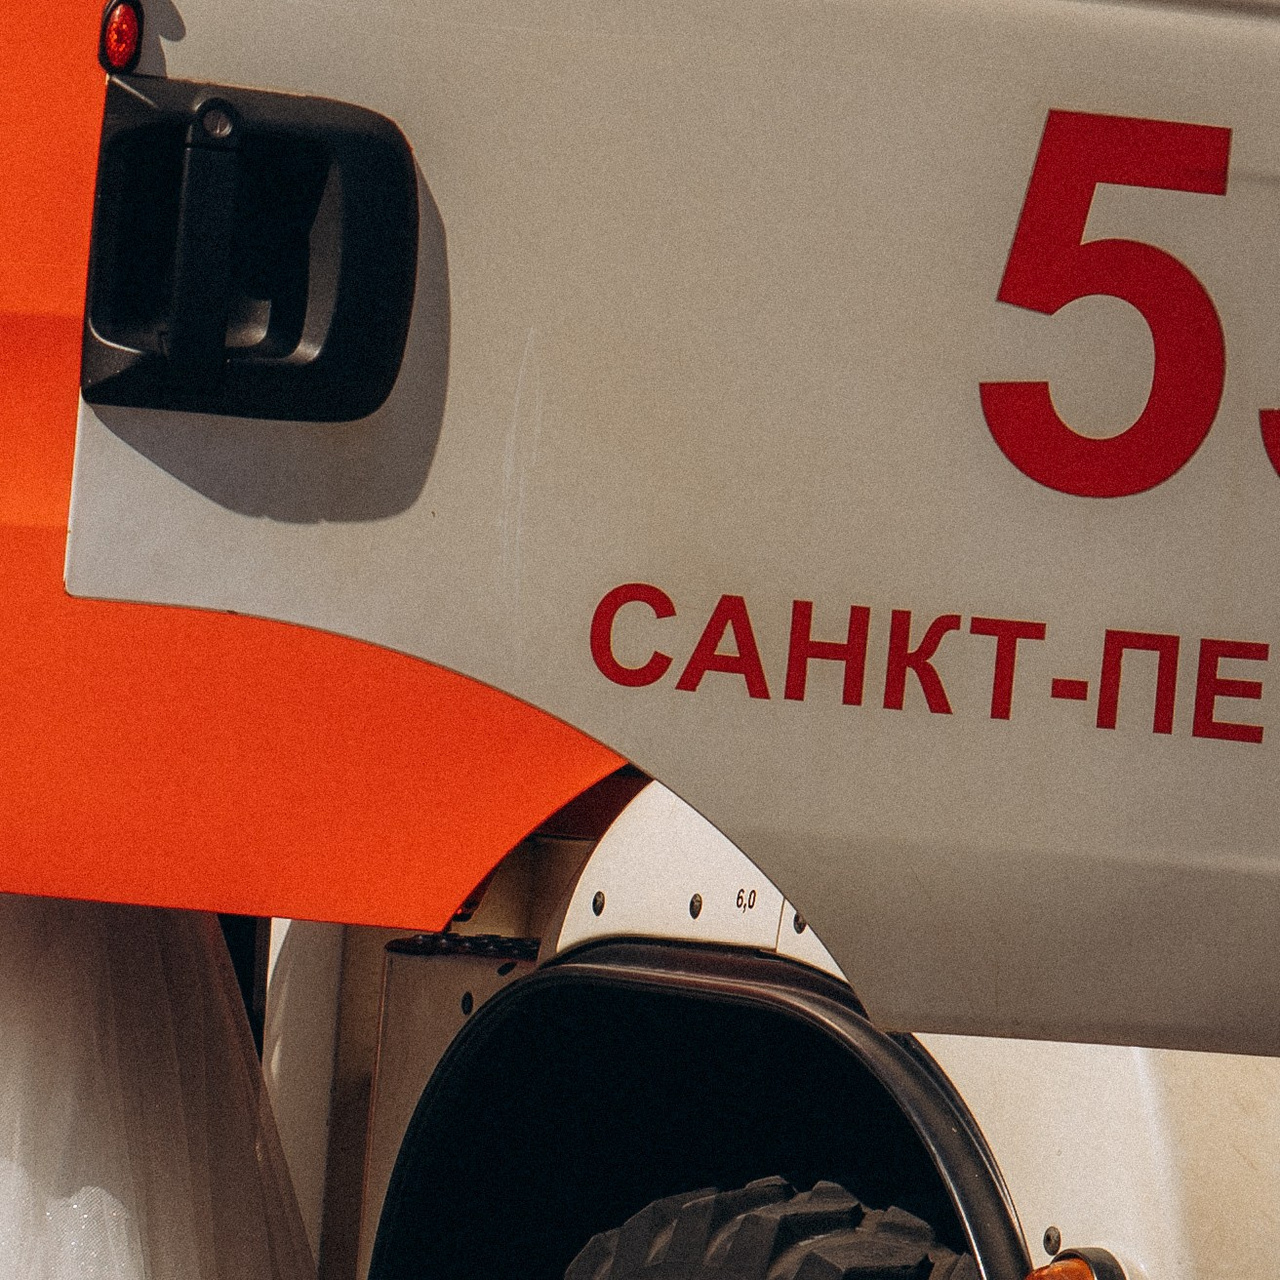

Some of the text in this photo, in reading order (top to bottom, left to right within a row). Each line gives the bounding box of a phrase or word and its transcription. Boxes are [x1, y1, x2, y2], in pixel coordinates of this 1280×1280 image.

[978, 108, 1280, 499] 5
[588, 582, 1271, 744] САНКТ-ПЕ
[736, 888, 757, 914] 6,0
